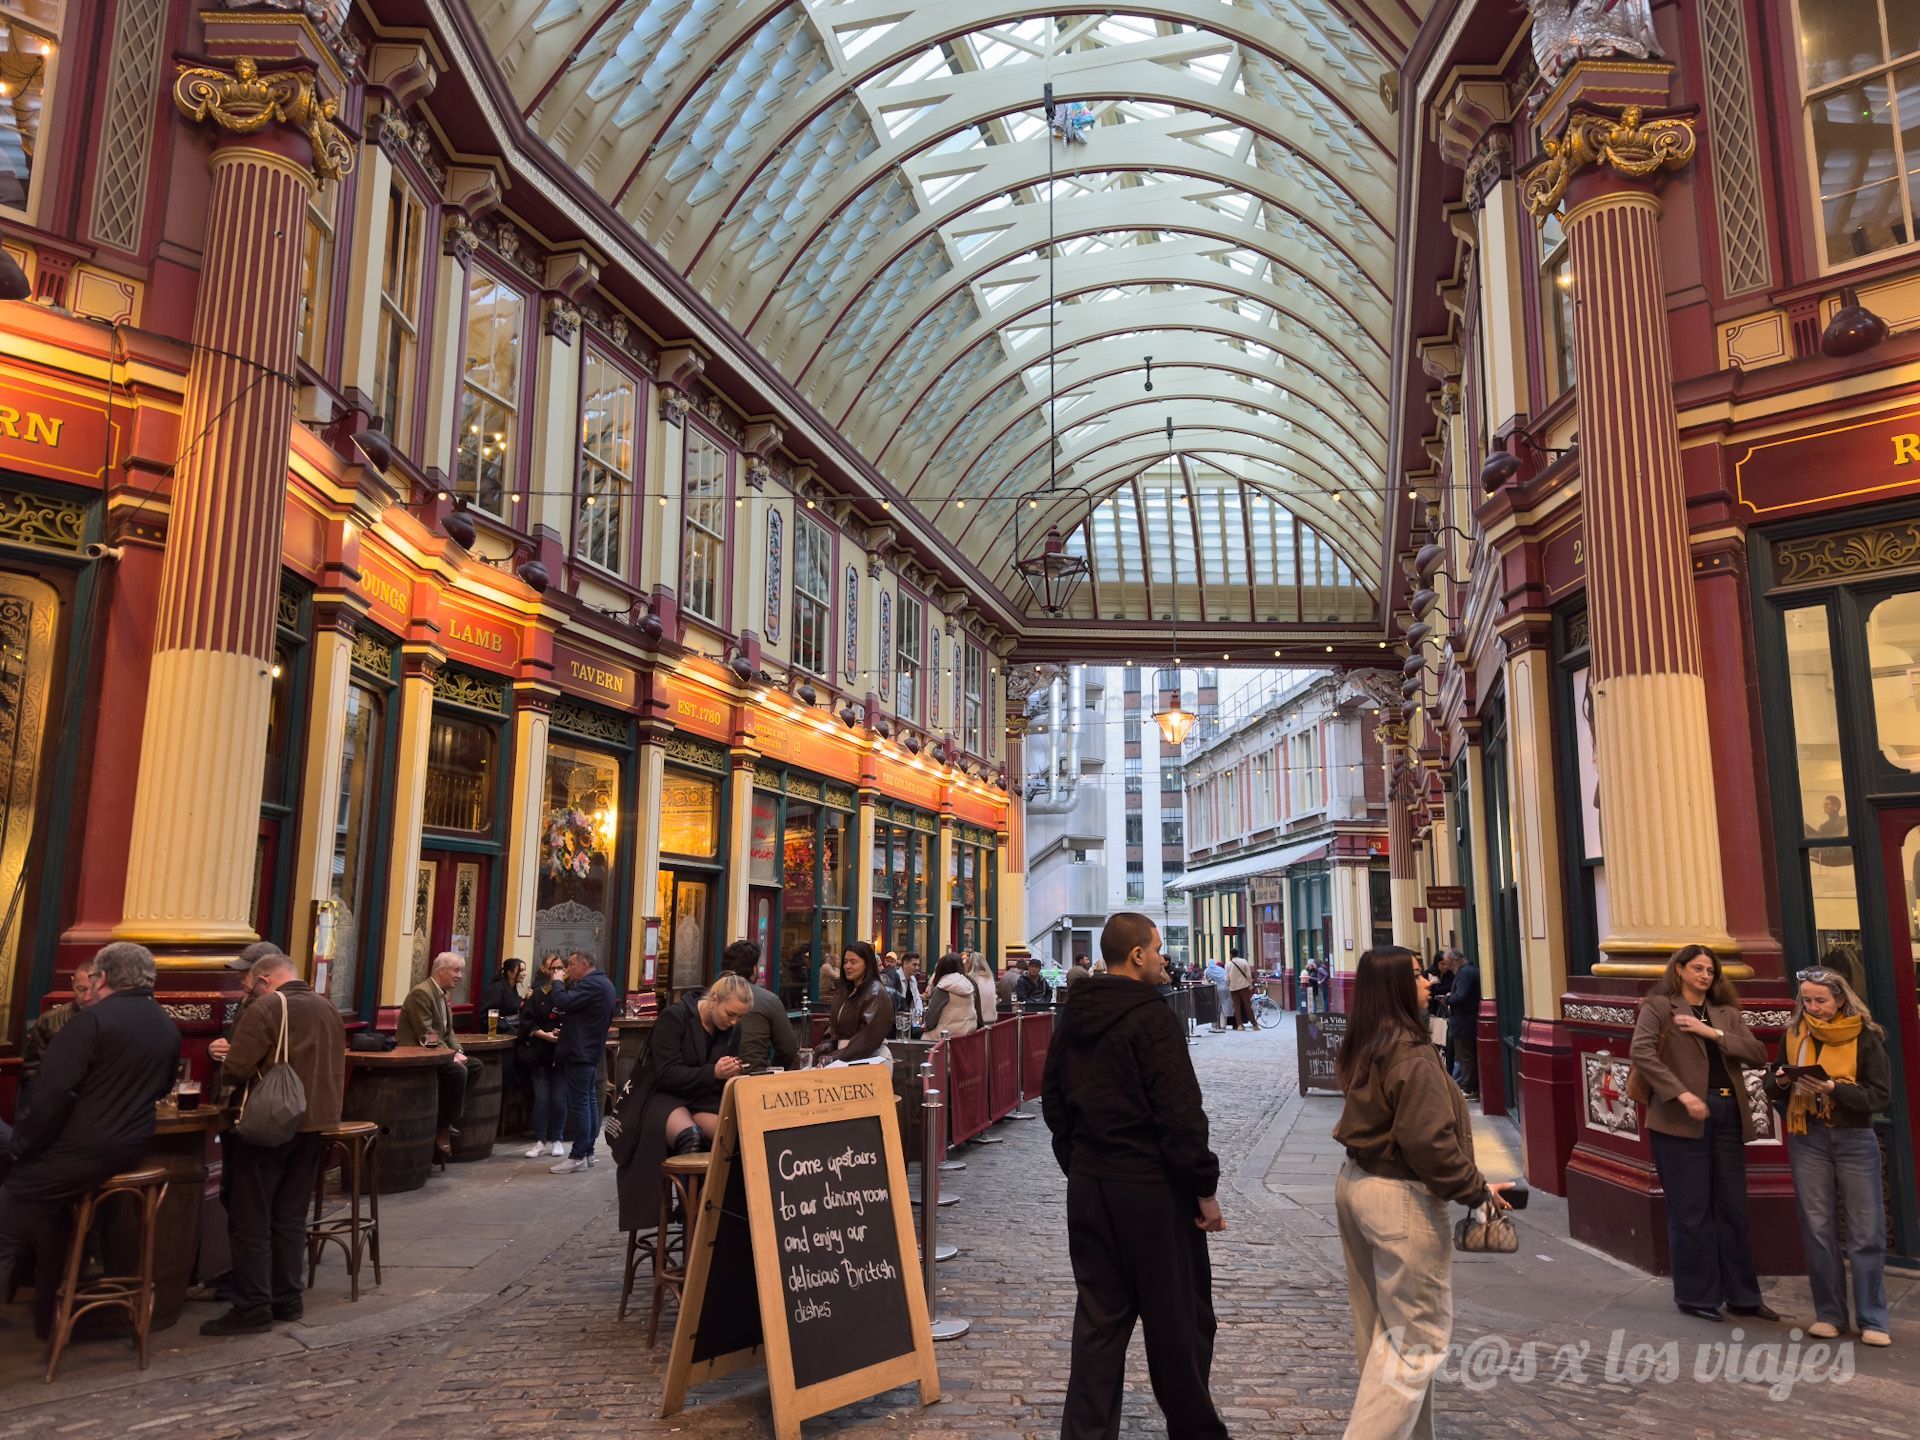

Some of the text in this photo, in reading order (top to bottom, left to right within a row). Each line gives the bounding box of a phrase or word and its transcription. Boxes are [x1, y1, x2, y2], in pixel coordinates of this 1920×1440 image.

[449, 618, 503, 652] LAMB
[570, 660, 624, 693] TAVERN
[1320, 1016, 1347, 1024] La Viña
[762, 1083, 874, 1110] LAMB TAVERN
[778, 1146, 877, 1181] Come upstairs
[779, 1191, 797, 1221] to
[823, 1181, 864, 1216] dining
[862, 1188, 889, 1203] room
[784, 1225, 868, 1254] and enjoy our
[788, 1258, 897, 1292] delicious British
[794, 1297, 831, 1323] dishes
